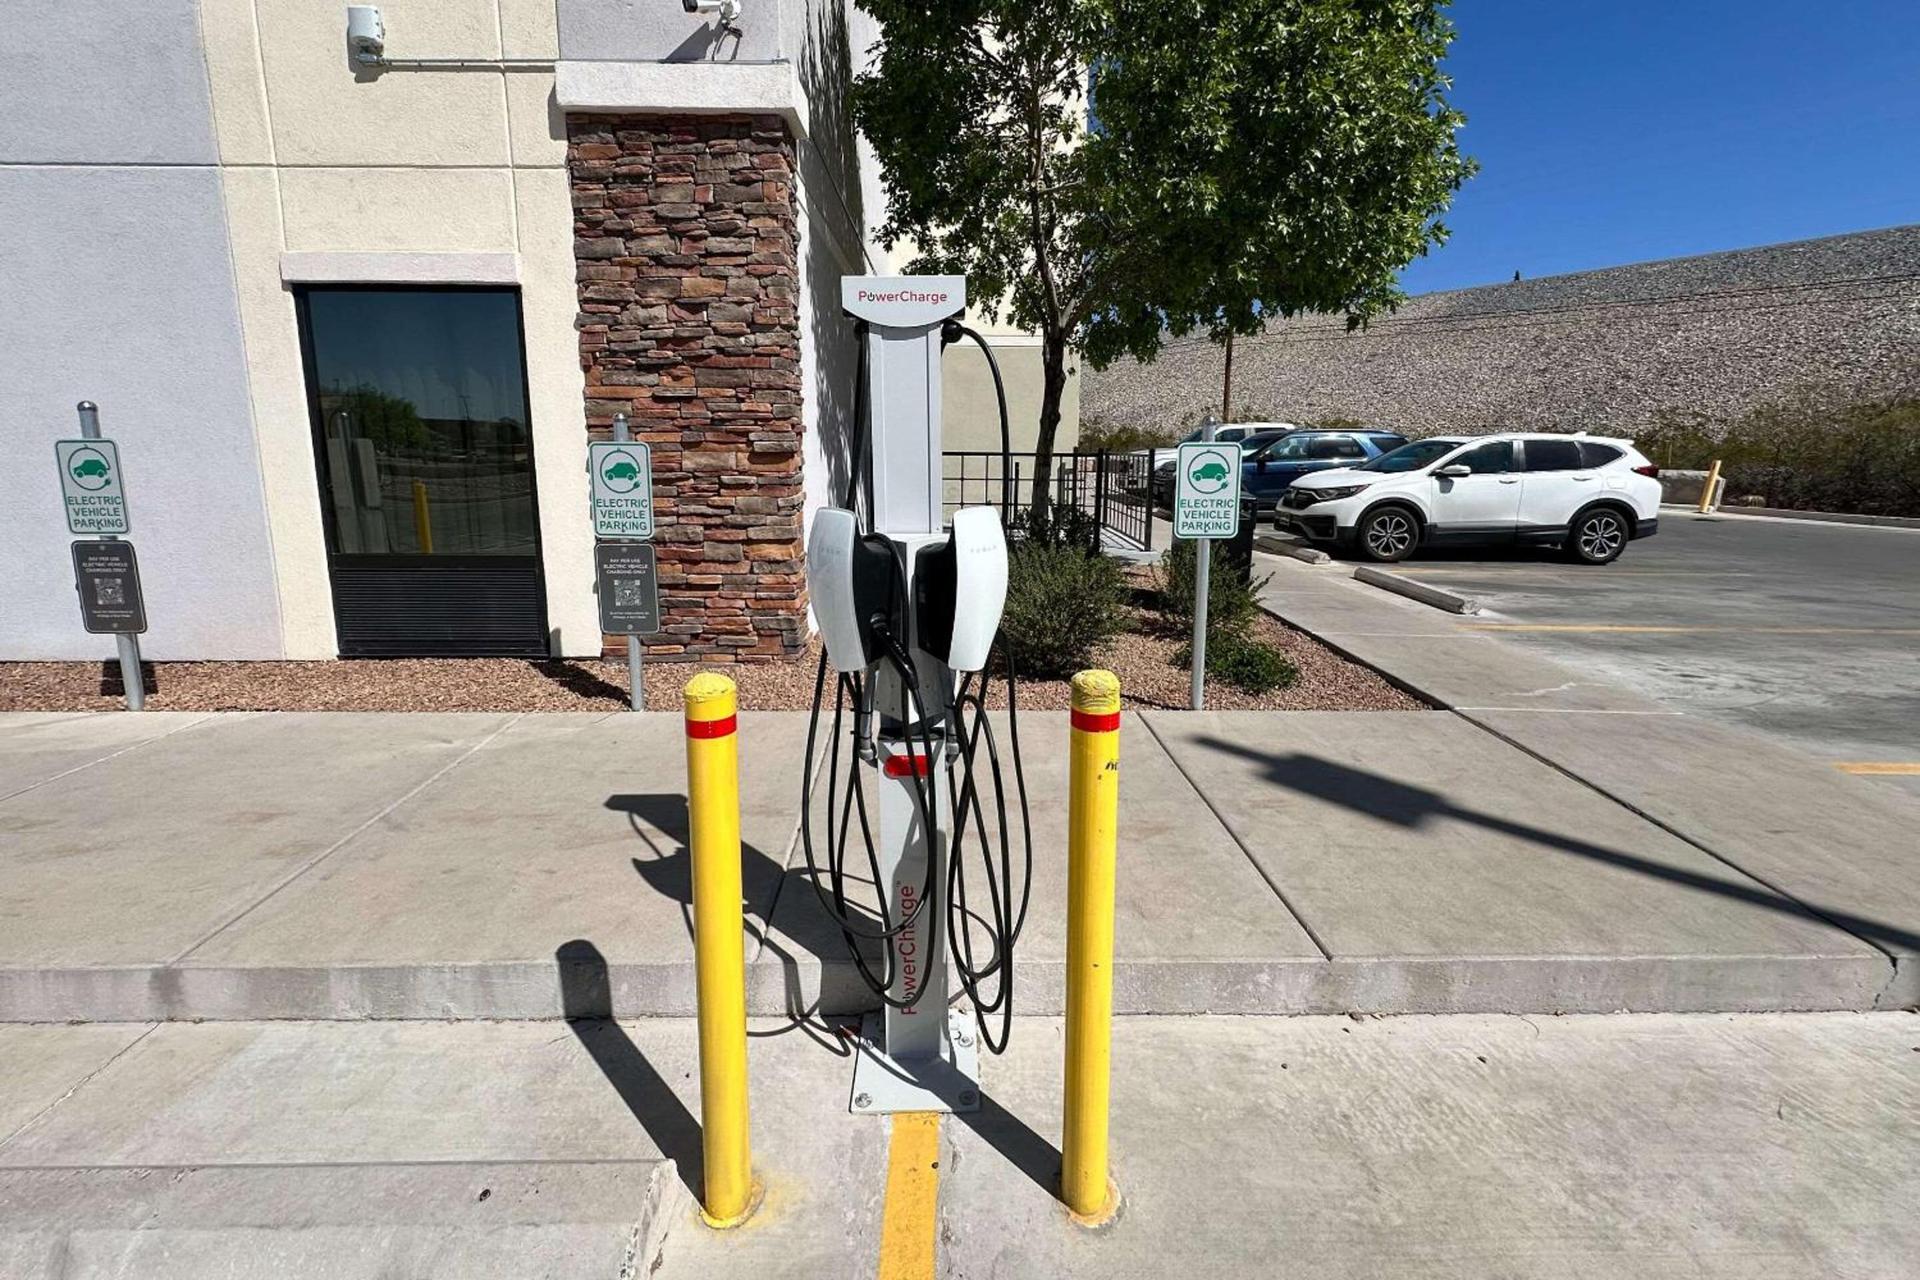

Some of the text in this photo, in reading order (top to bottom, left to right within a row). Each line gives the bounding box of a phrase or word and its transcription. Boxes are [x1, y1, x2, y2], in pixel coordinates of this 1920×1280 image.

[858, 291, 948, 305] PowerCharge
[67, 496, 122, 506] ELECTRIC
[596, 499, 648, 508] ELECTRIC
[1180, 499, 1234, 508] ELECTRIC
[73, 507, 121, 517] VEHICLE
[600, 510, 646, 519] VEHICLE
[1183, 510, 1231, 519] VEHICLE
[73, 519, 124, 528] PARKING
[599, 521, 647, 530] PARKING
[1181, 521, 1231, 530] PARKING
